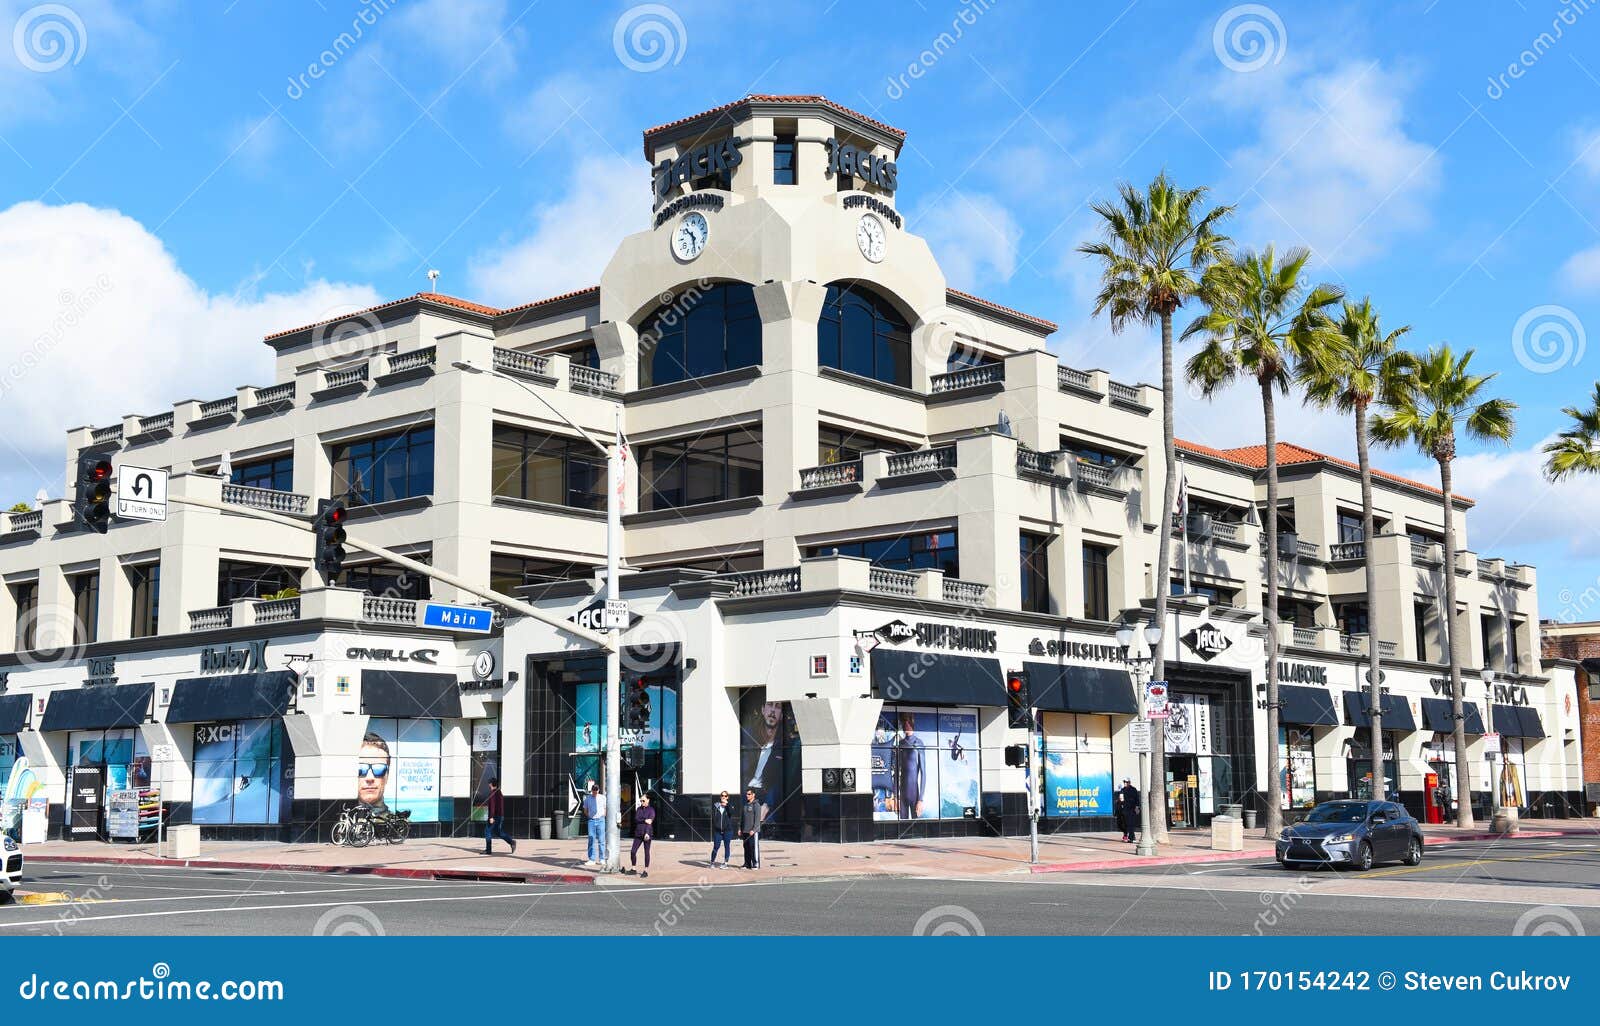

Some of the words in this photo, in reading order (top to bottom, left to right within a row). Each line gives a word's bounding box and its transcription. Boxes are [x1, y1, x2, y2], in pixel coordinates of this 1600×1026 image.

[131, 505, 147, 513] TURN
[149, 507, 165, 516] ONLY
[441, 611, 476, 626] Main
[608, 609, 627, 617] ROUTE
[916, 622, 997, 653] SURFBOARDS
[201, 646, 250, 675] Hurley
[346, 647, 409, 662] O'NEILL
[1046, 639, 1125, 663] QUIKSILVER
[1493, 684, 1530, 707] RVCA
[206, 724, 246, 743] XCEL
[1199, 697, 1207, 752] G-SHOCK
[1091, 786, 1100, 797] of
